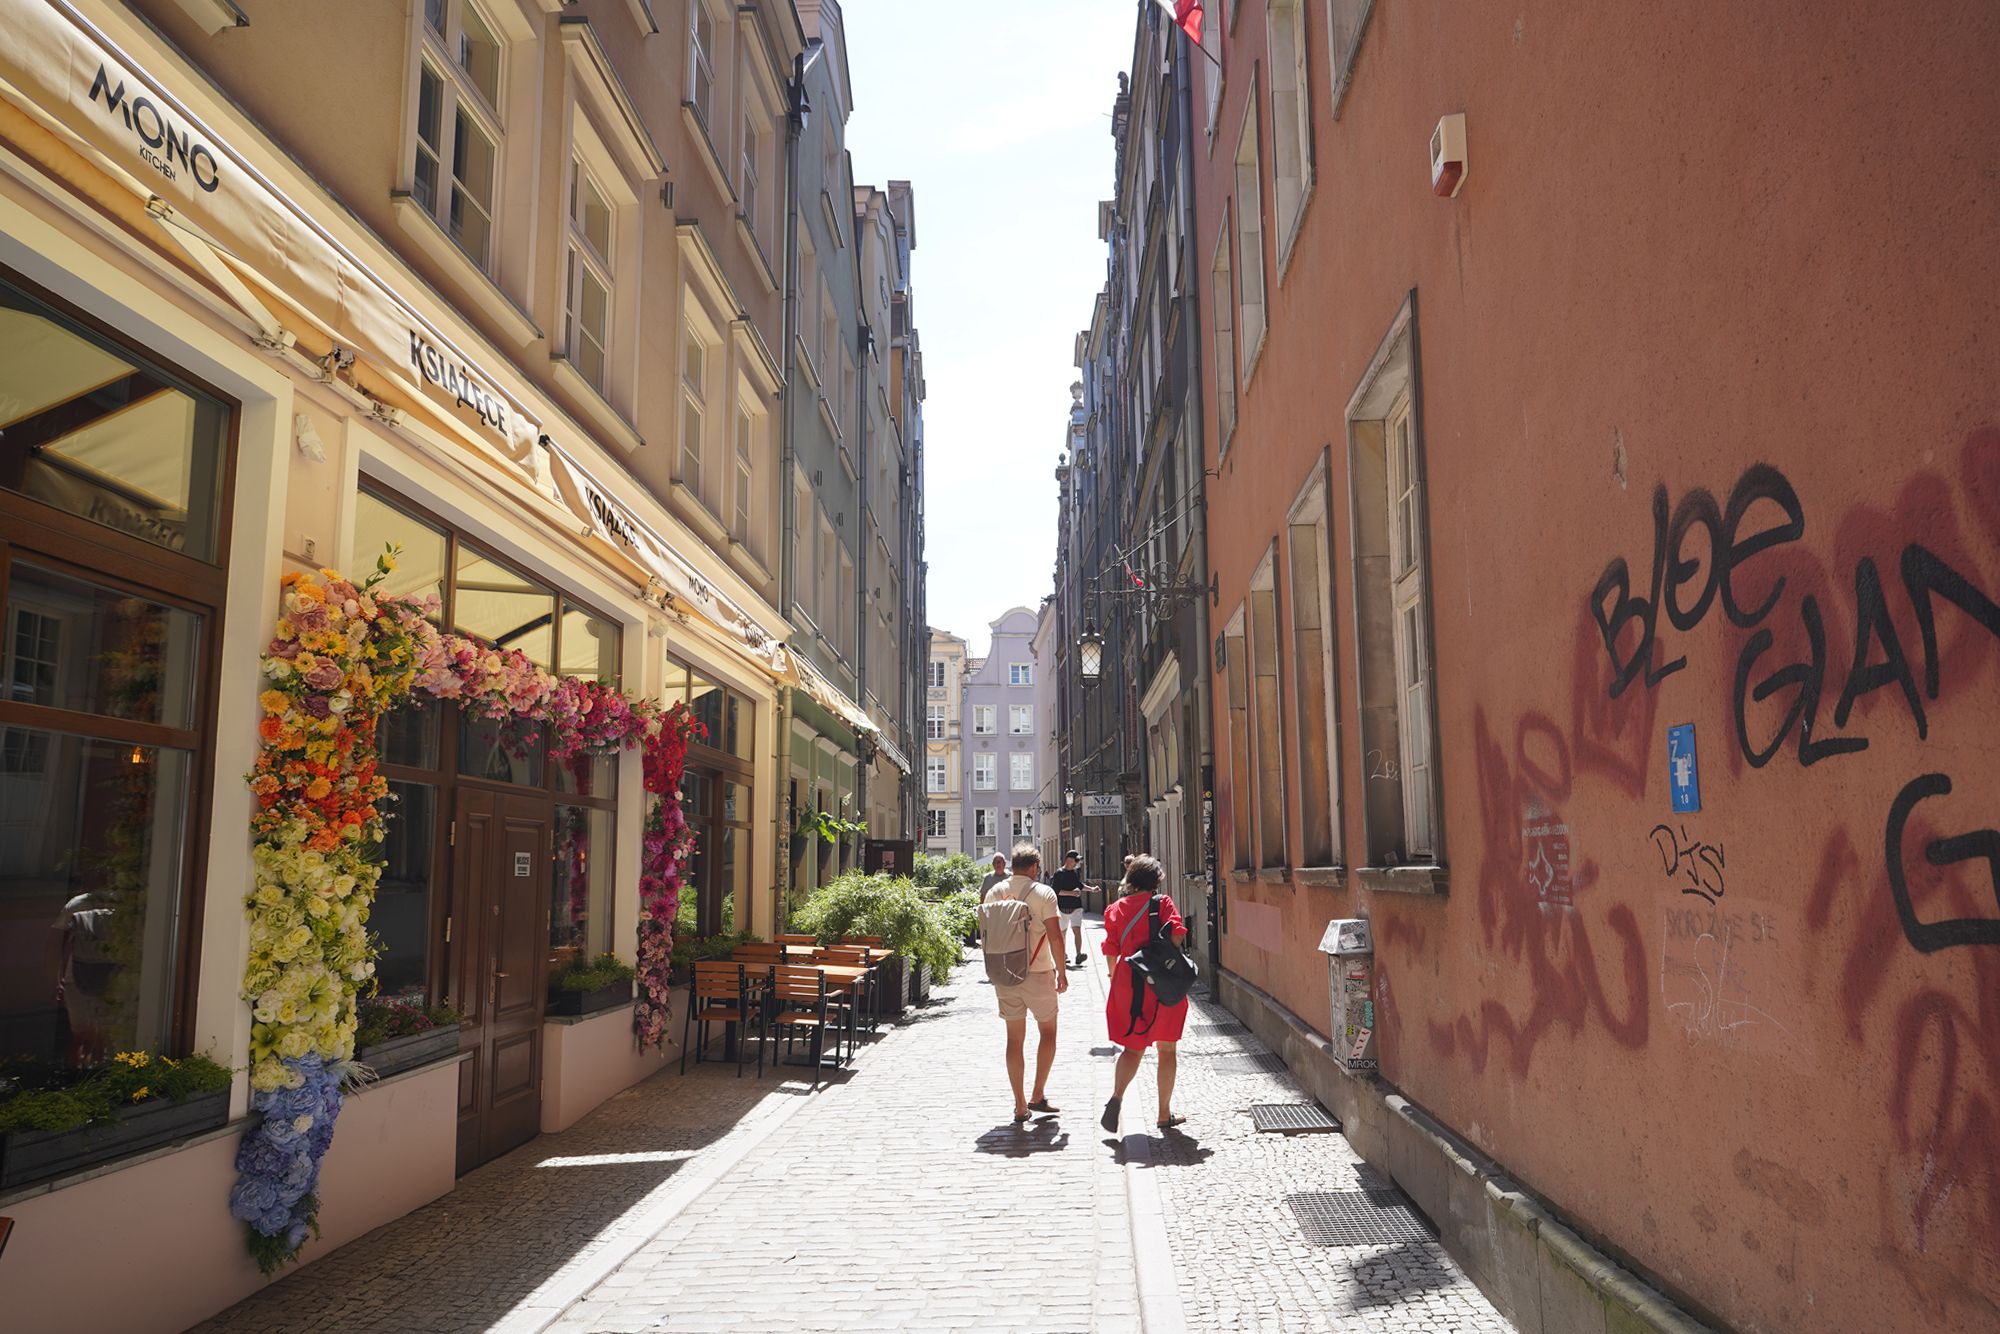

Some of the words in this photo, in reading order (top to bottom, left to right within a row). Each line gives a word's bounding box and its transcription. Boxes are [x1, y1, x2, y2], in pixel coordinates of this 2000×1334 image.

[88, 62, 219, 193] MONO
[139, 144, 176, 181] KITCHEN
[409, 328, 509, 437] KSIĄŻĘCE
[688, 575, 709, 603] MONO
[1348, 1060, 1377, 1069] MROK
